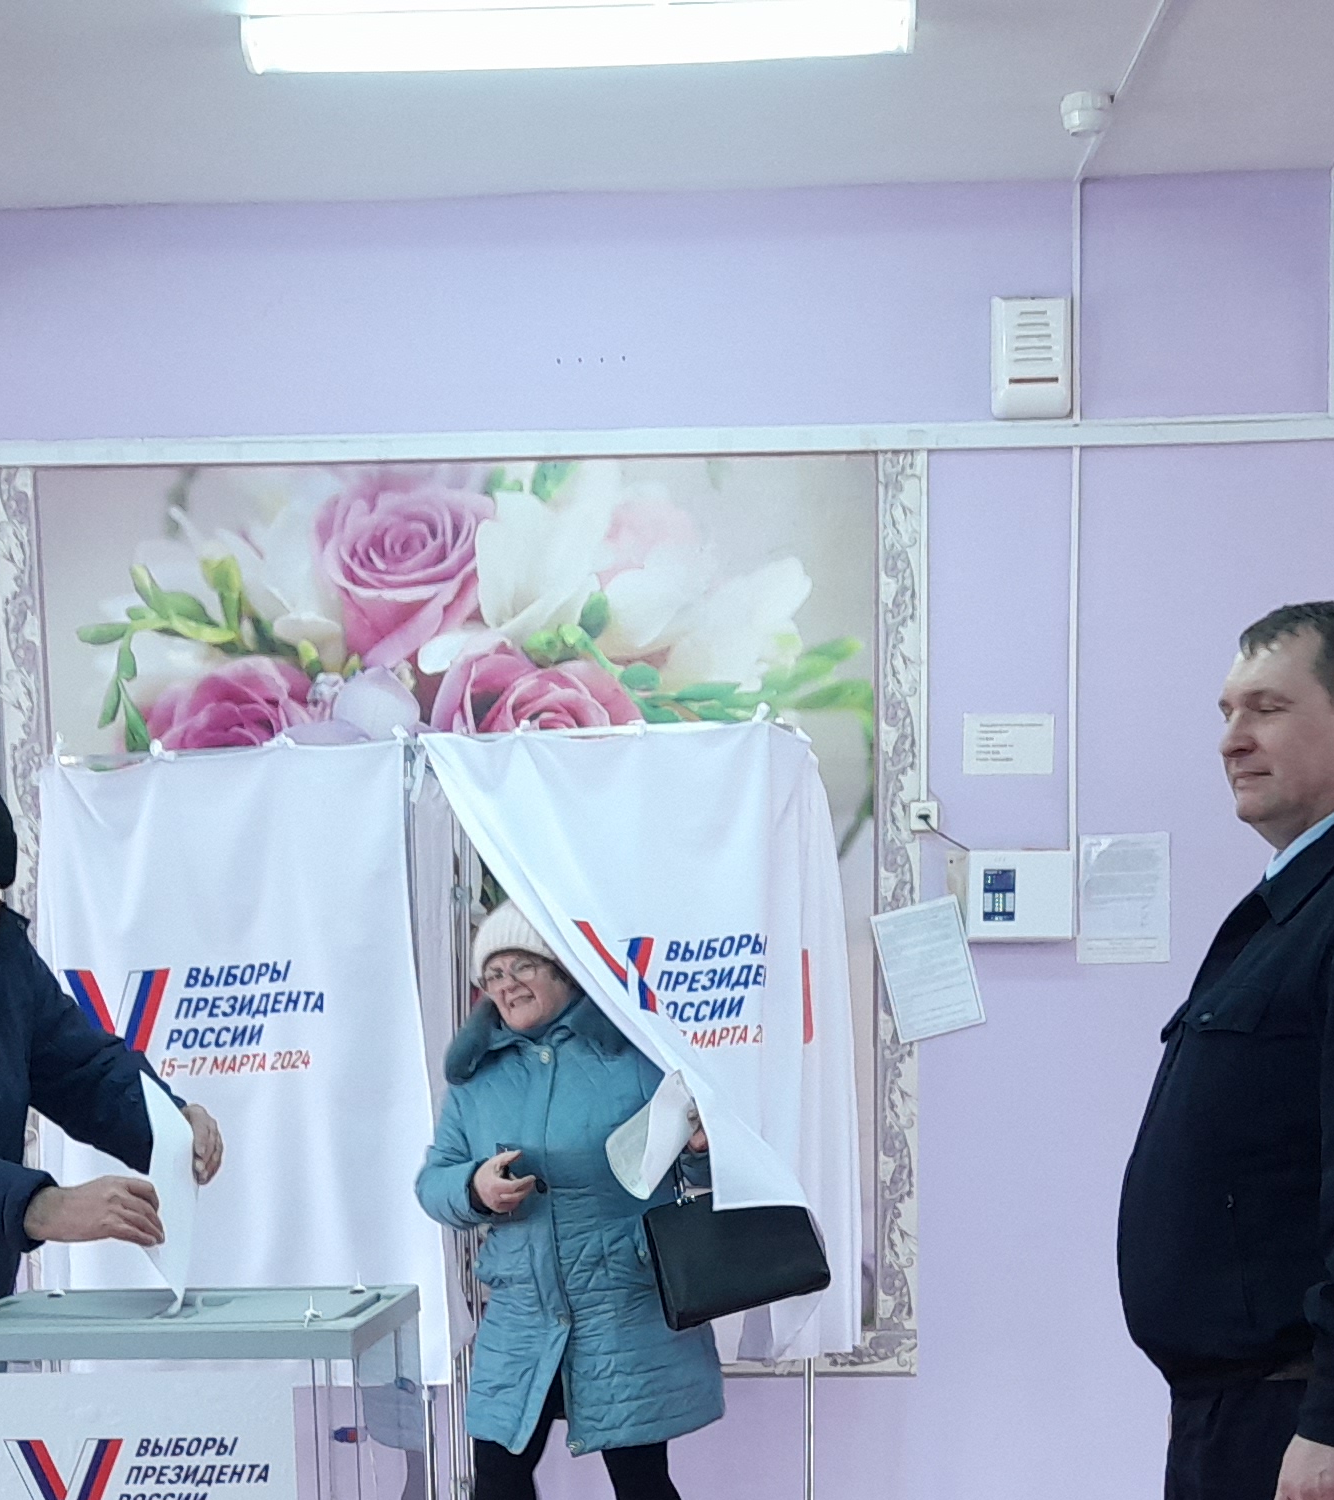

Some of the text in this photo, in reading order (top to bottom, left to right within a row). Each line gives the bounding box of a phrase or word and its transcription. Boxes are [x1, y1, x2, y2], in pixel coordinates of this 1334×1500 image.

[664, 932, 767, 962] ВЫБОРЫ
[184, 959, 292, 989] ВЫБОРЫ
[657, 964, 766, 992] ПРЕЗИДЕ
[174, 990, 324, 1020] ПРЕЗИДЕНТА
[662, 995, 746, 1023] ОССИИ
[165, 1023, 264, 1051] РОССИИ
[690, 1024, 749, 1049] МАРТА
[159, 1049, 311, 1078] 15–17 МАРТА 2024
[135, 1437, 238, 1457] ВЫБОРЫ
[125, 1463, 270, 1487] ПРЕЗИДЕНТА
